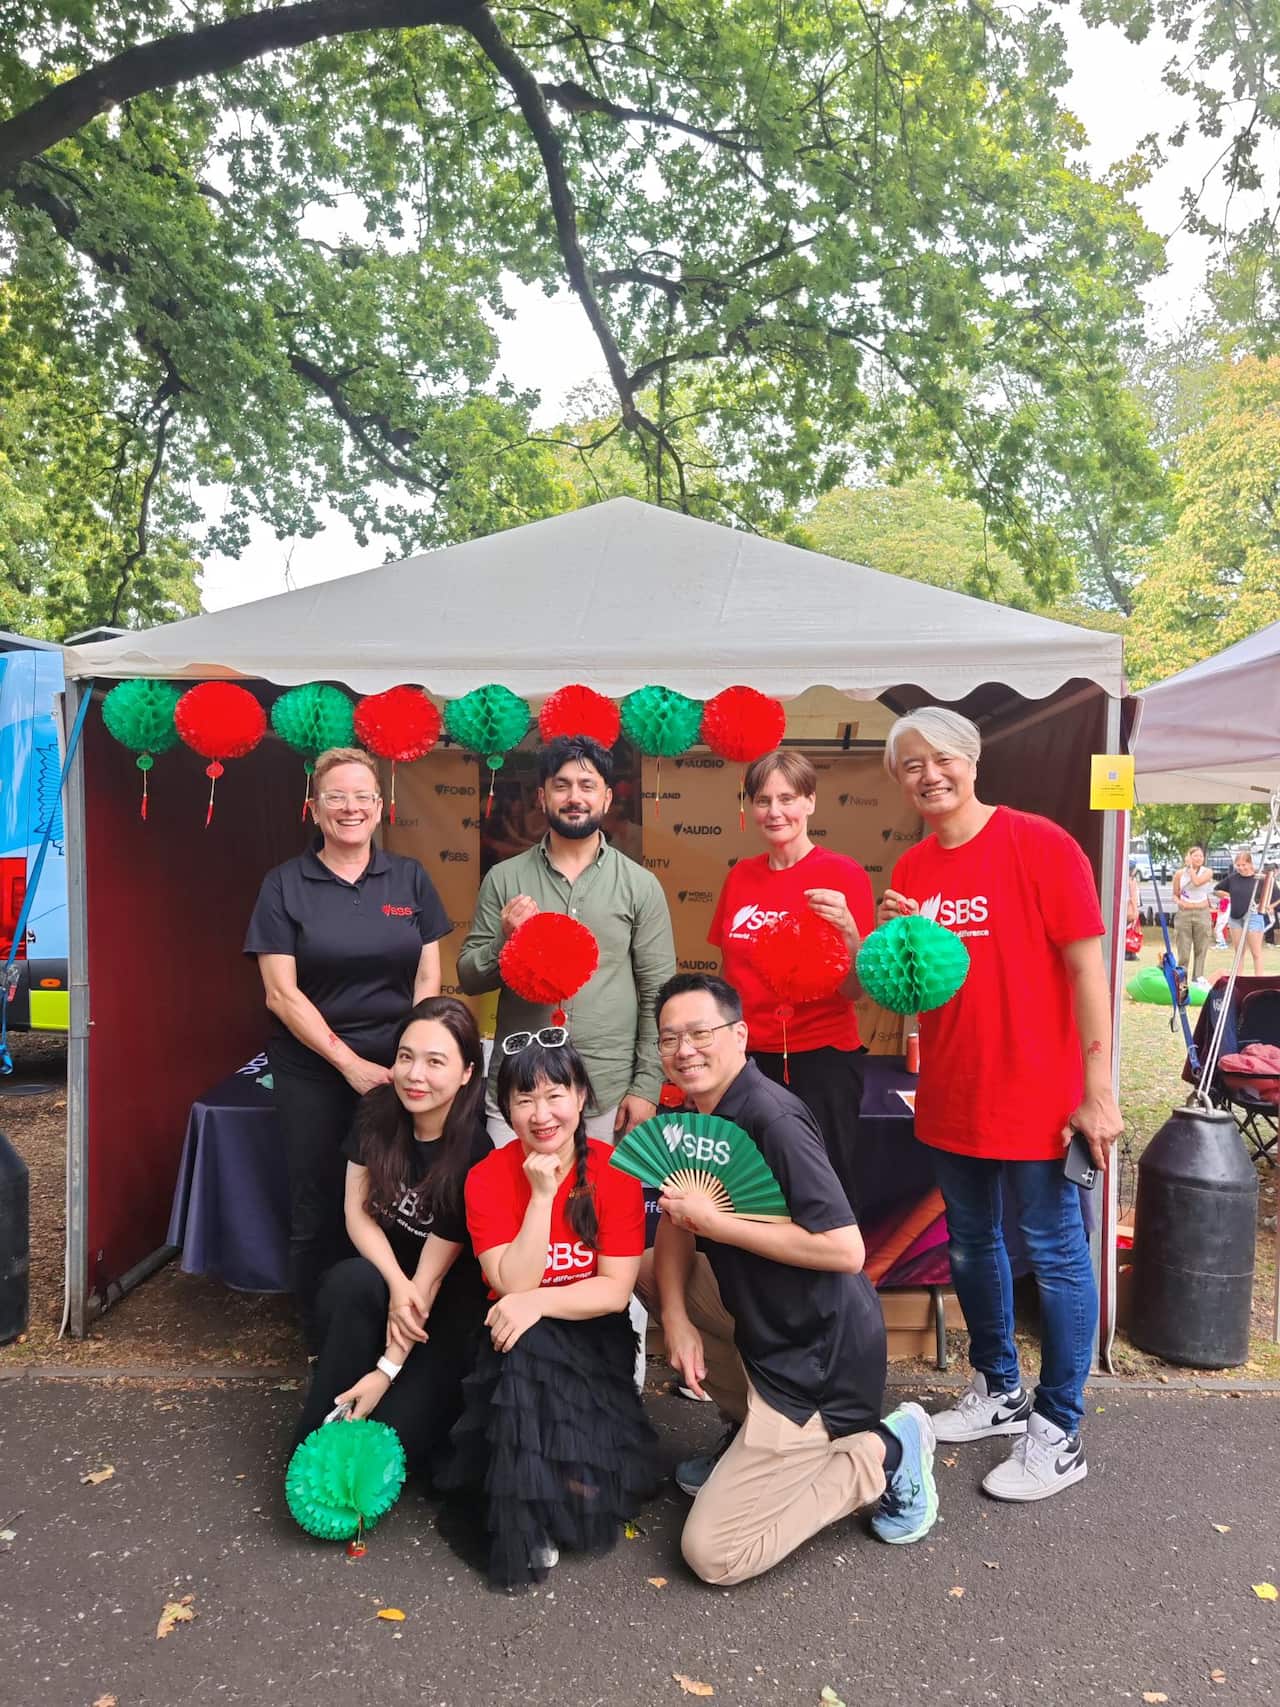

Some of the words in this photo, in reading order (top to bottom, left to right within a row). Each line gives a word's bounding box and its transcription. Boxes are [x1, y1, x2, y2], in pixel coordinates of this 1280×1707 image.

[443, 785, 476, 796] FOOD
[685, 825, 722, 835] AUDIO
[448, 851, 470, 863] SBS
[645, 858, 671, 869] NITV
[391, 906, 413, 916] SBS
[940, 895, 989, 926] SBS
[681, 960, 718, 970] AUDIO
[682, 1133, 731, 1166] SBS
